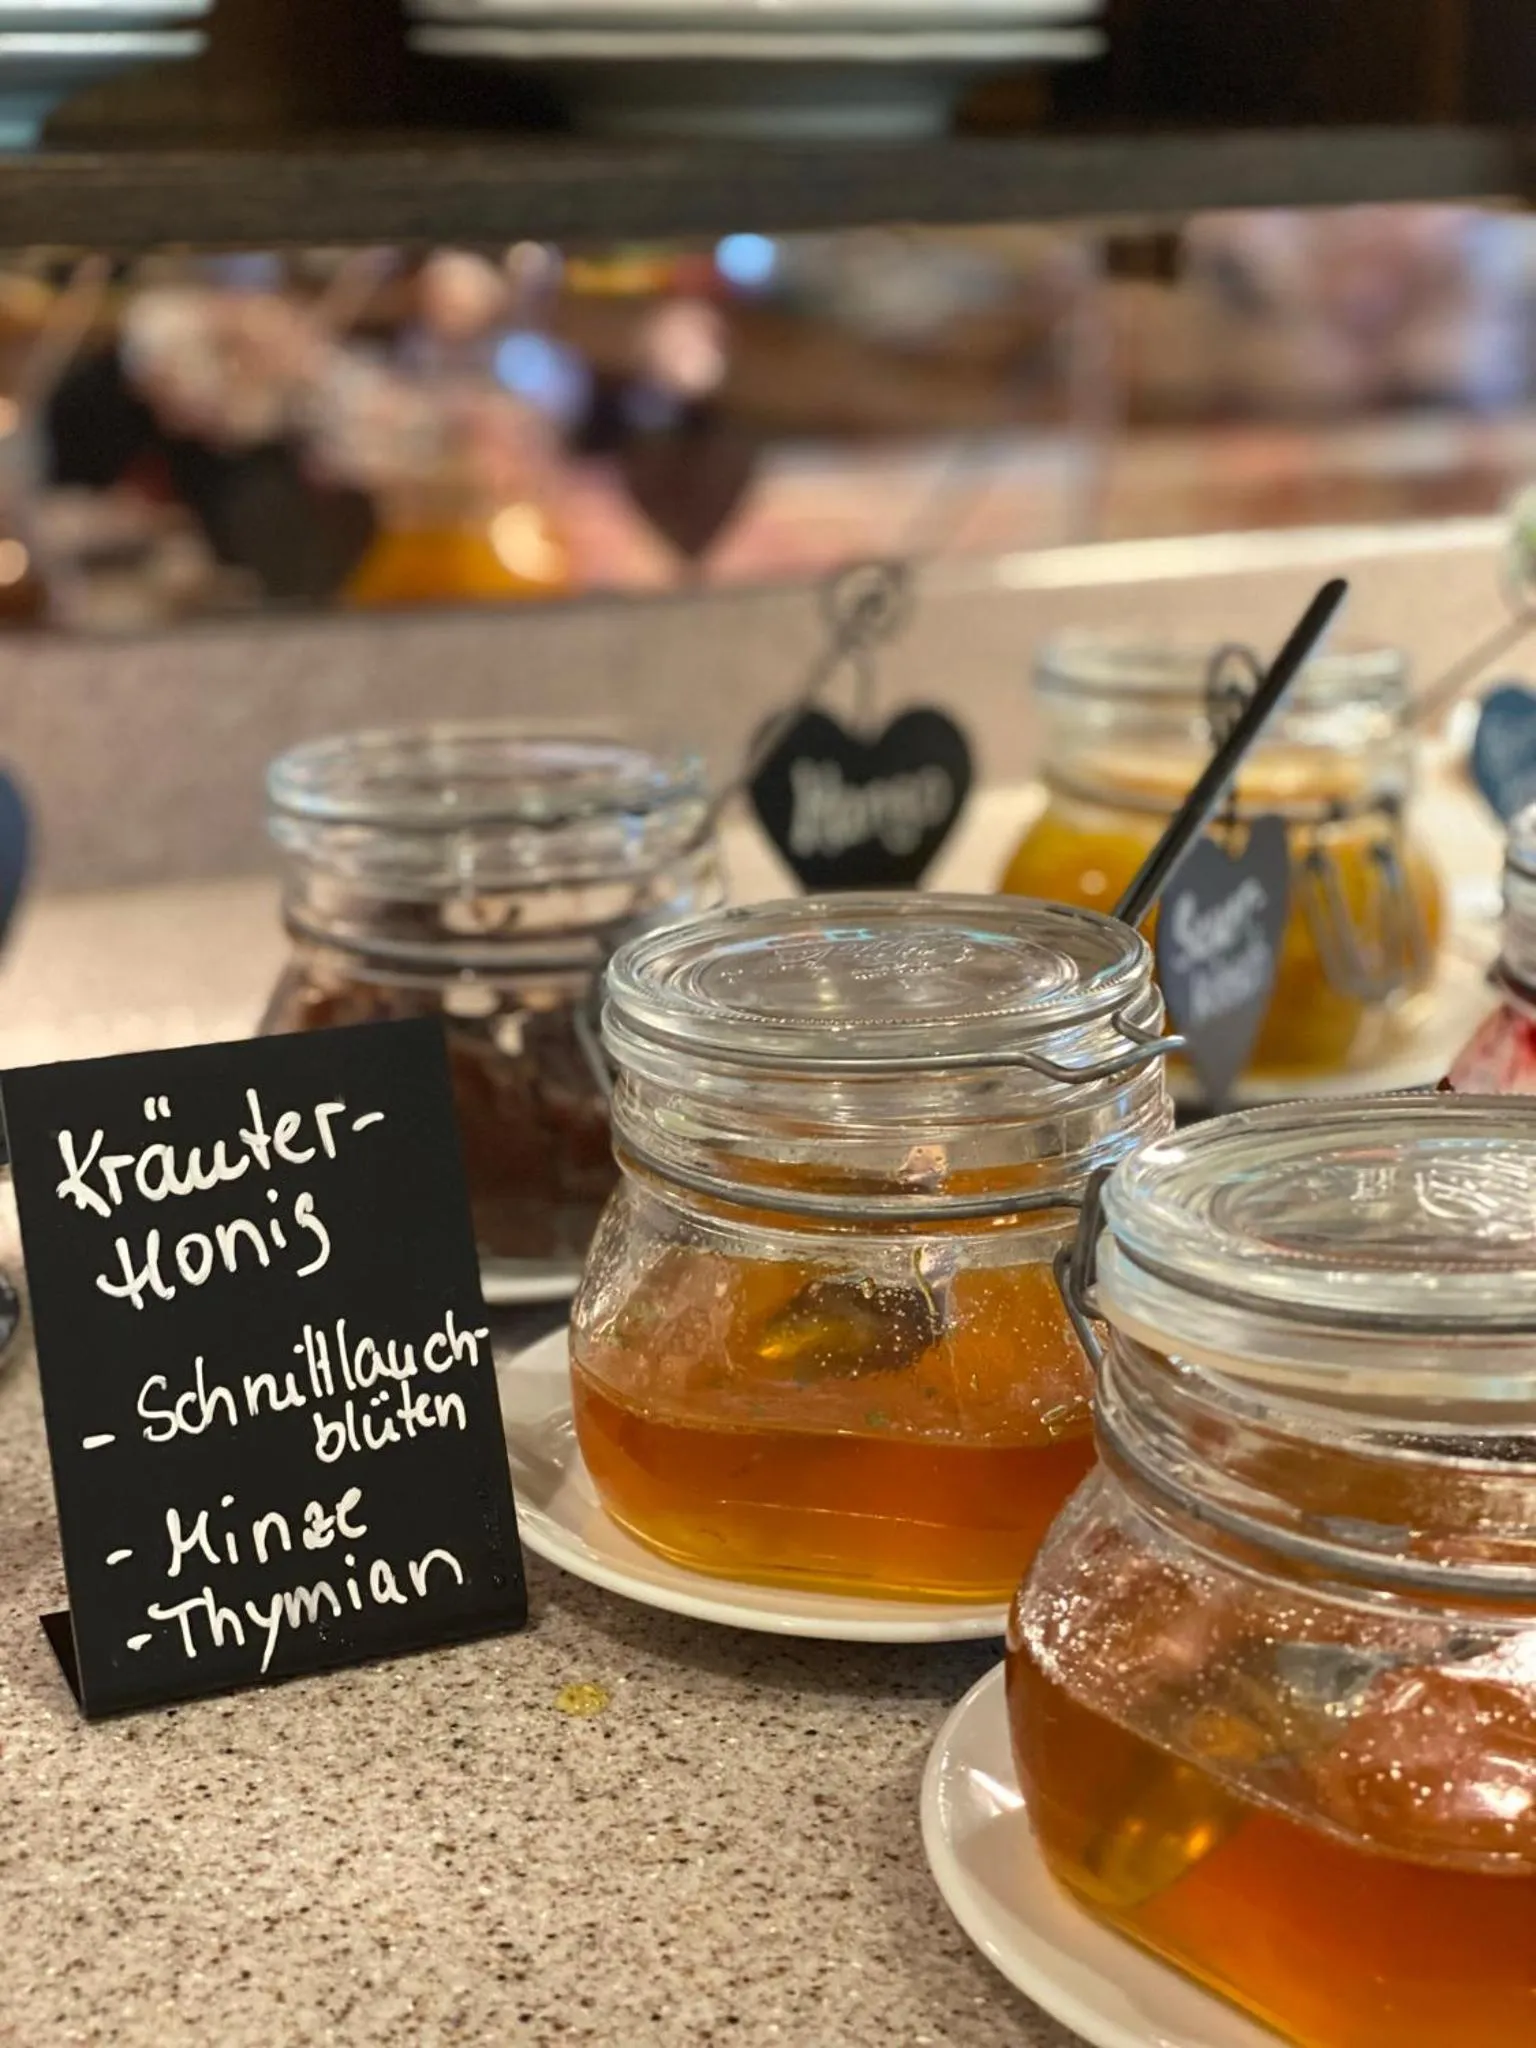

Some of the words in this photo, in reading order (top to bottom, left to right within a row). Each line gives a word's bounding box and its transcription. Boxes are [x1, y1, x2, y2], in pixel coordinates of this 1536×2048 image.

[56, 1088, 385, 1218] Kräuter-
[96, 1188, 331, 1311] Honig
[312, 1380, 467, 1464] blüten
[166, 1486, 368, 1578] Minze
